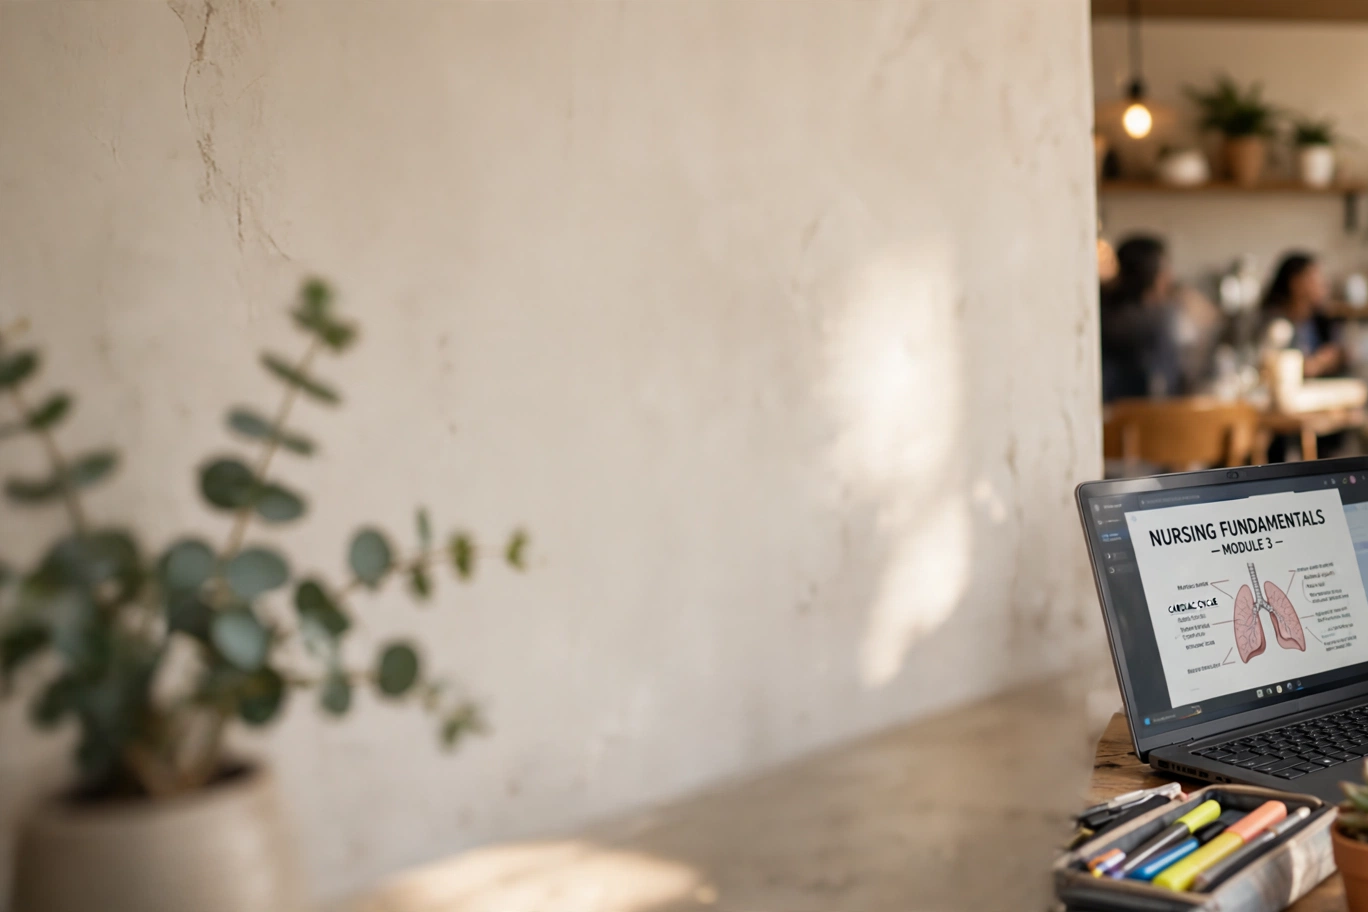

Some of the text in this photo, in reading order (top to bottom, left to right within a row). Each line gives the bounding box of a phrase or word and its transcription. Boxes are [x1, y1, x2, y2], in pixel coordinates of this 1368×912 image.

[1149, 509, 1326, 547] NURSING FUNDAMENTALS
[1221, 538, 1265, 555] MODULE
[1265, 537, 1273, 549] 3
